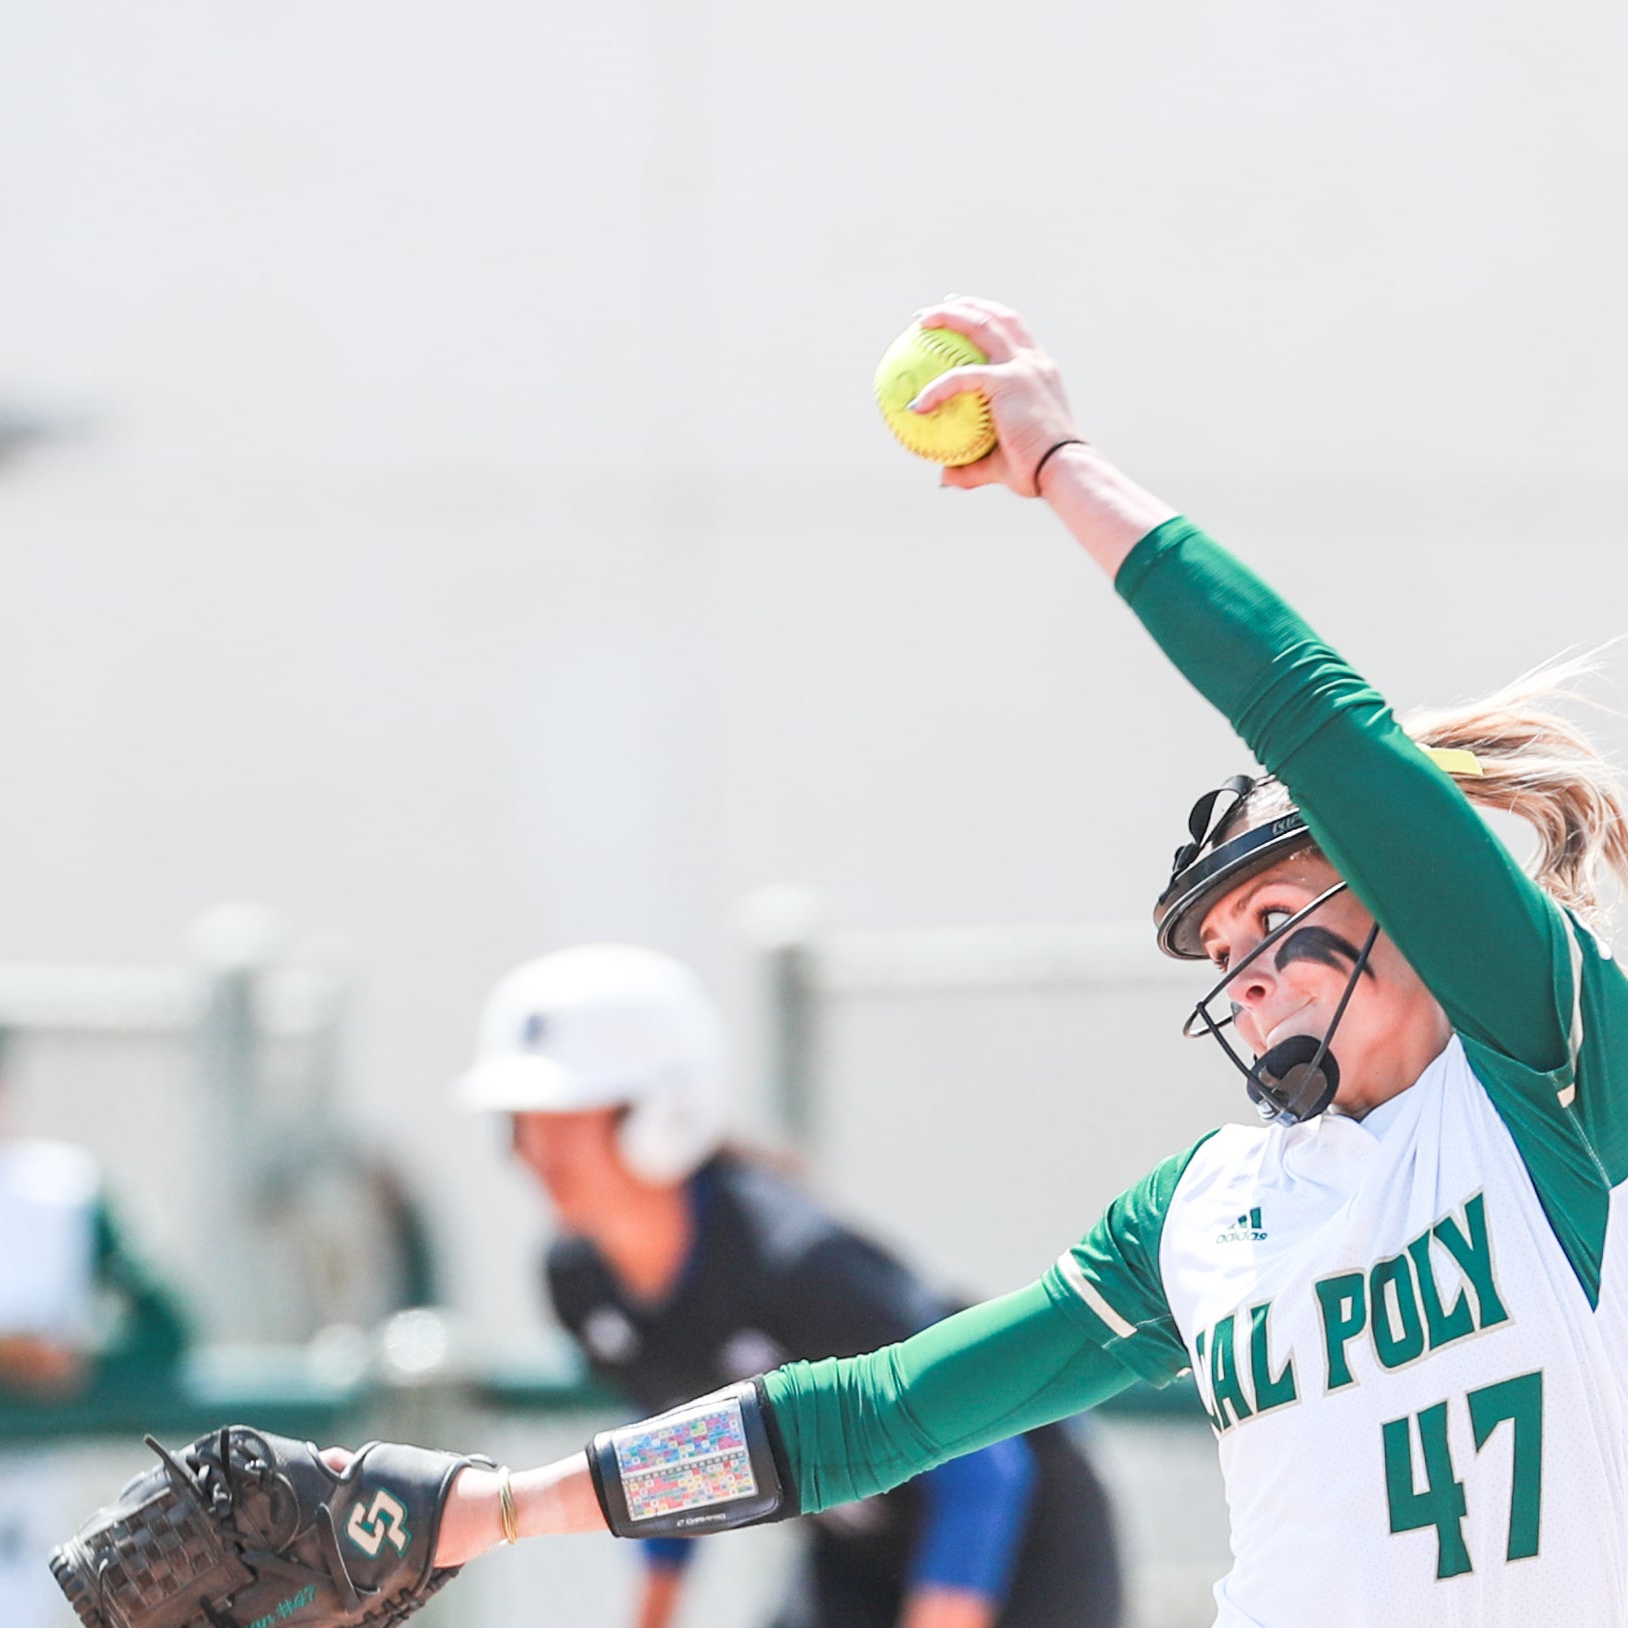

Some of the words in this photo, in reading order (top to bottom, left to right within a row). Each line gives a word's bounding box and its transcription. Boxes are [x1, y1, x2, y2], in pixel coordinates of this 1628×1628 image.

[1314, 1189, 1513, 1393] POLY
[1381, 1370, 1543, 1580] 47
[276, 1584, 316, 1619] #47
